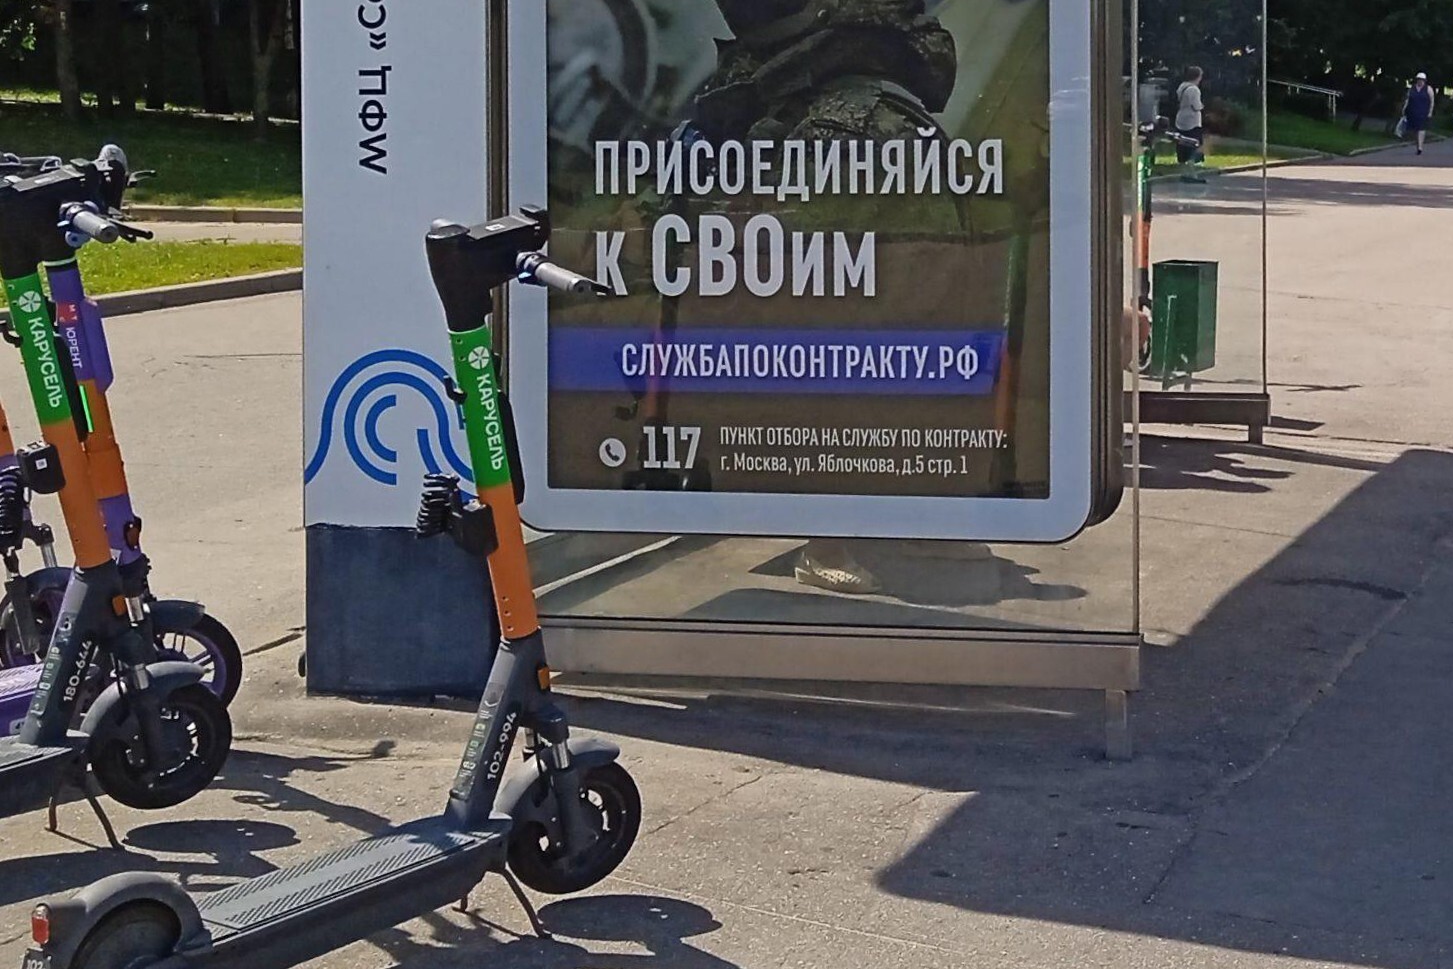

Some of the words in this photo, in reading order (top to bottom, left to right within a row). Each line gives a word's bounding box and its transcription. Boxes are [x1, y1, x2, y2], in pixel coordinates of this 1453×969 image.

[358, 65, 392, 175] МФЦ
[594, 127, 1003, 201] ПРИСОЕДИНЯЙСЯ
[28, 317, 63, 409] КАРУСЕЛЬ
[65, 326, 83, 369] ЮРЕНТ
[621, 342, 980, 381] СЛУЖБАПОКОНТРАКТУ.РФ
[476, 373, 504, 471] КАРУСЕЛЬ
[642, 426, 701, 469] 117
[720, 426, 763, 446] ПУНКТ
[766, 427, 819, 447] ОТБОРА
[821, 428, 840, 447] НА
[842, 428, 898, 449] СЛУЖБУ
[901, 429, 921, 448] ПО
[924, 429, 1008, 450] КОНТРАКТУ:
[720, 454, 731, 471] г.
[734, 452, 792, 474] Москва,
[795, 456, 815, 476] ул.
[818, 453, 900, 477] Яблочкова,
[902, 454, 924, 476] д.5
[928, 457, 957, 478] стр.
[960, 455, 968, 474] 1
[63, 640, 93, 702] 180-644
[487, 712, 517, 780] 102-994
